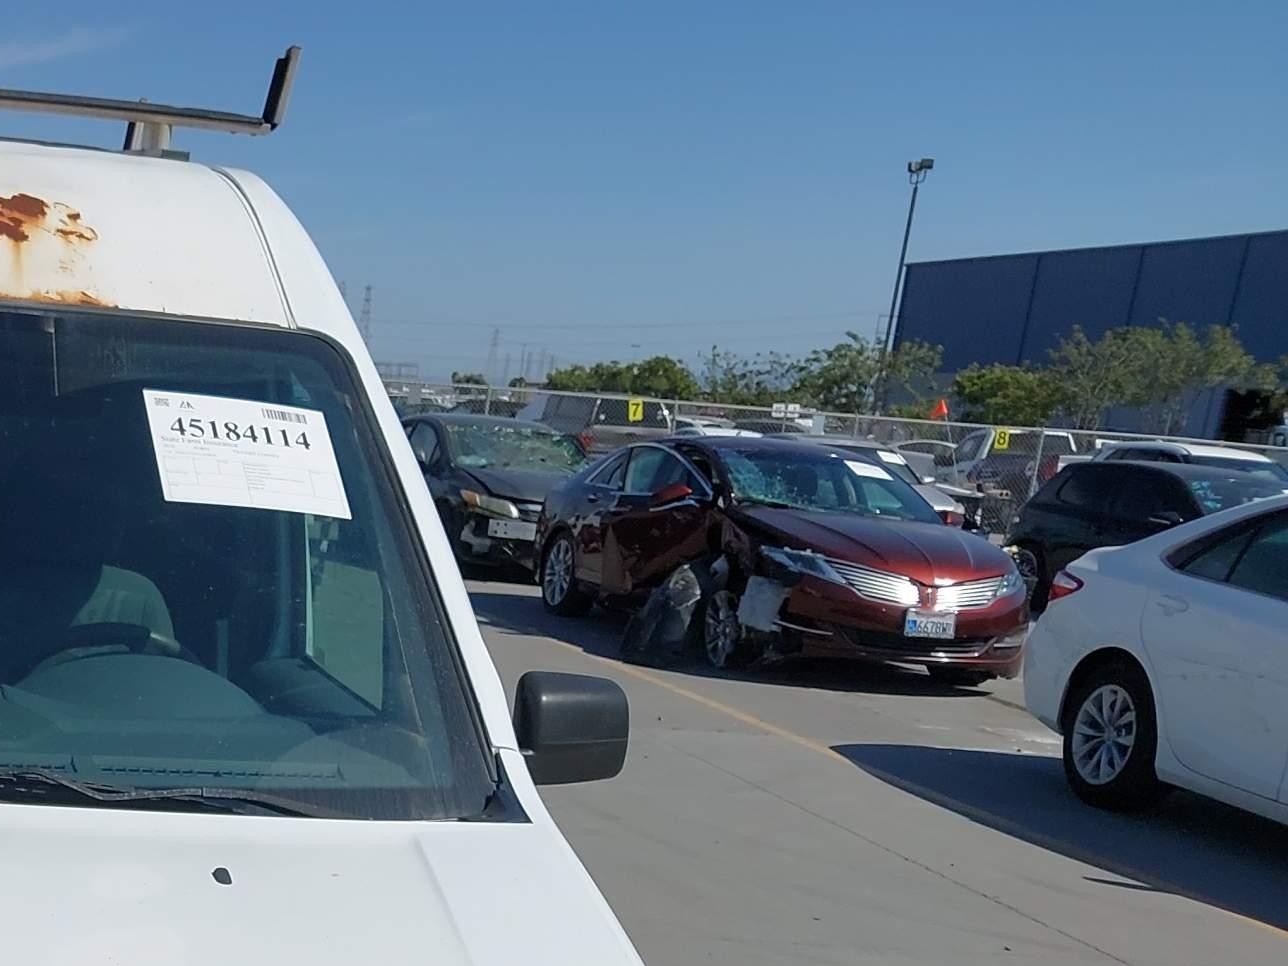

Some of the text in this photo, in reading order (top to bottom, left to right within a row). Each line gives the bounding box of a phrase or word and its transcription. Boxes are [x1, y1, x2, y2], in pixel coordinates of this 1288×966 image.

[631, 402, 640, 418] 7
[170, 416, 311, 450] 45184114
[997, 431, 1007, 446] 8
